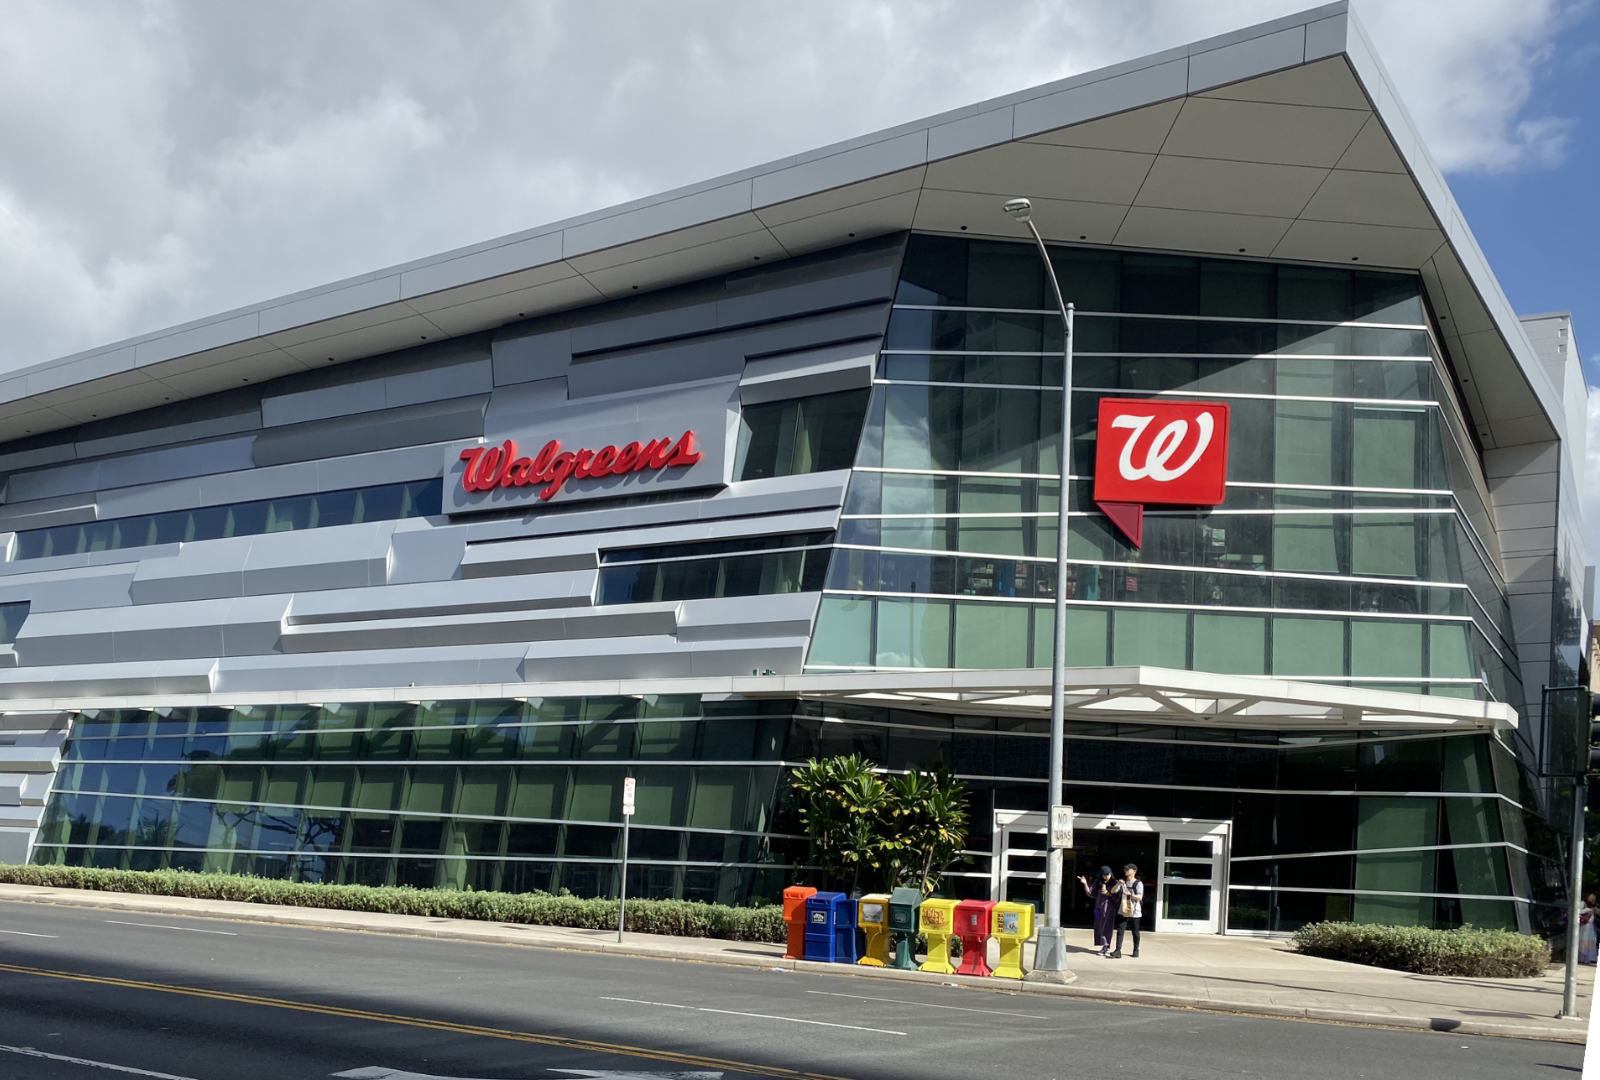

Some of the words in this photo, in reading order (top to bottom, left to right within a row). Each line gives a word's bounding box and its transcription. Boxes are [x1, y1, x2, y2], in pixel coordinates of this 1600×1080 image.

[460, 430, 702, 501] Walgreens
[1111, 412, 1214, 482] W
[1054, 831, 1071, 841] TURNS
[1058, 813, 1067, 824] NO
